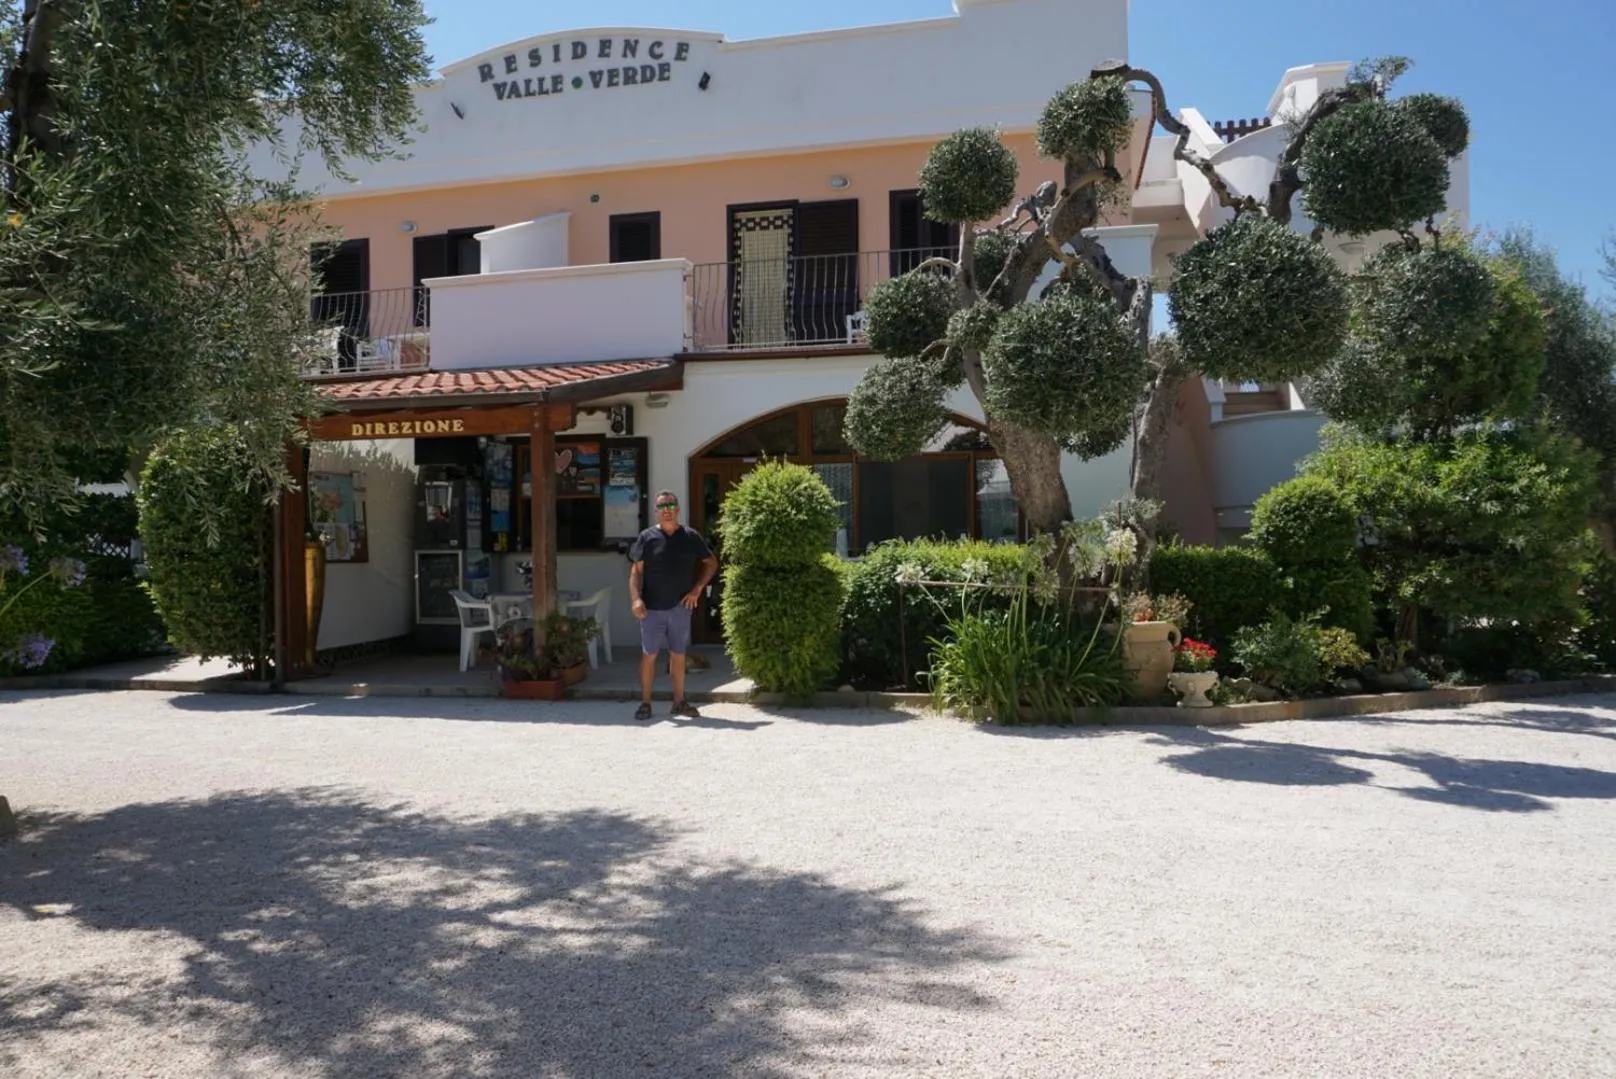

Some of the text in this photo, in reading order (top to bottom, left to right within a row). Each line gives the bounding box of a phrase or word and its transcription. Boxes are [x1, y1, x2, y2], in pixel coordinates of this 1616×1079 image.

[478, 39, 690, 82] RESIDENCE
[493, 62, 671, 101] VALLE VERDE
[351, 419, 465, 436] DIREZIONE
